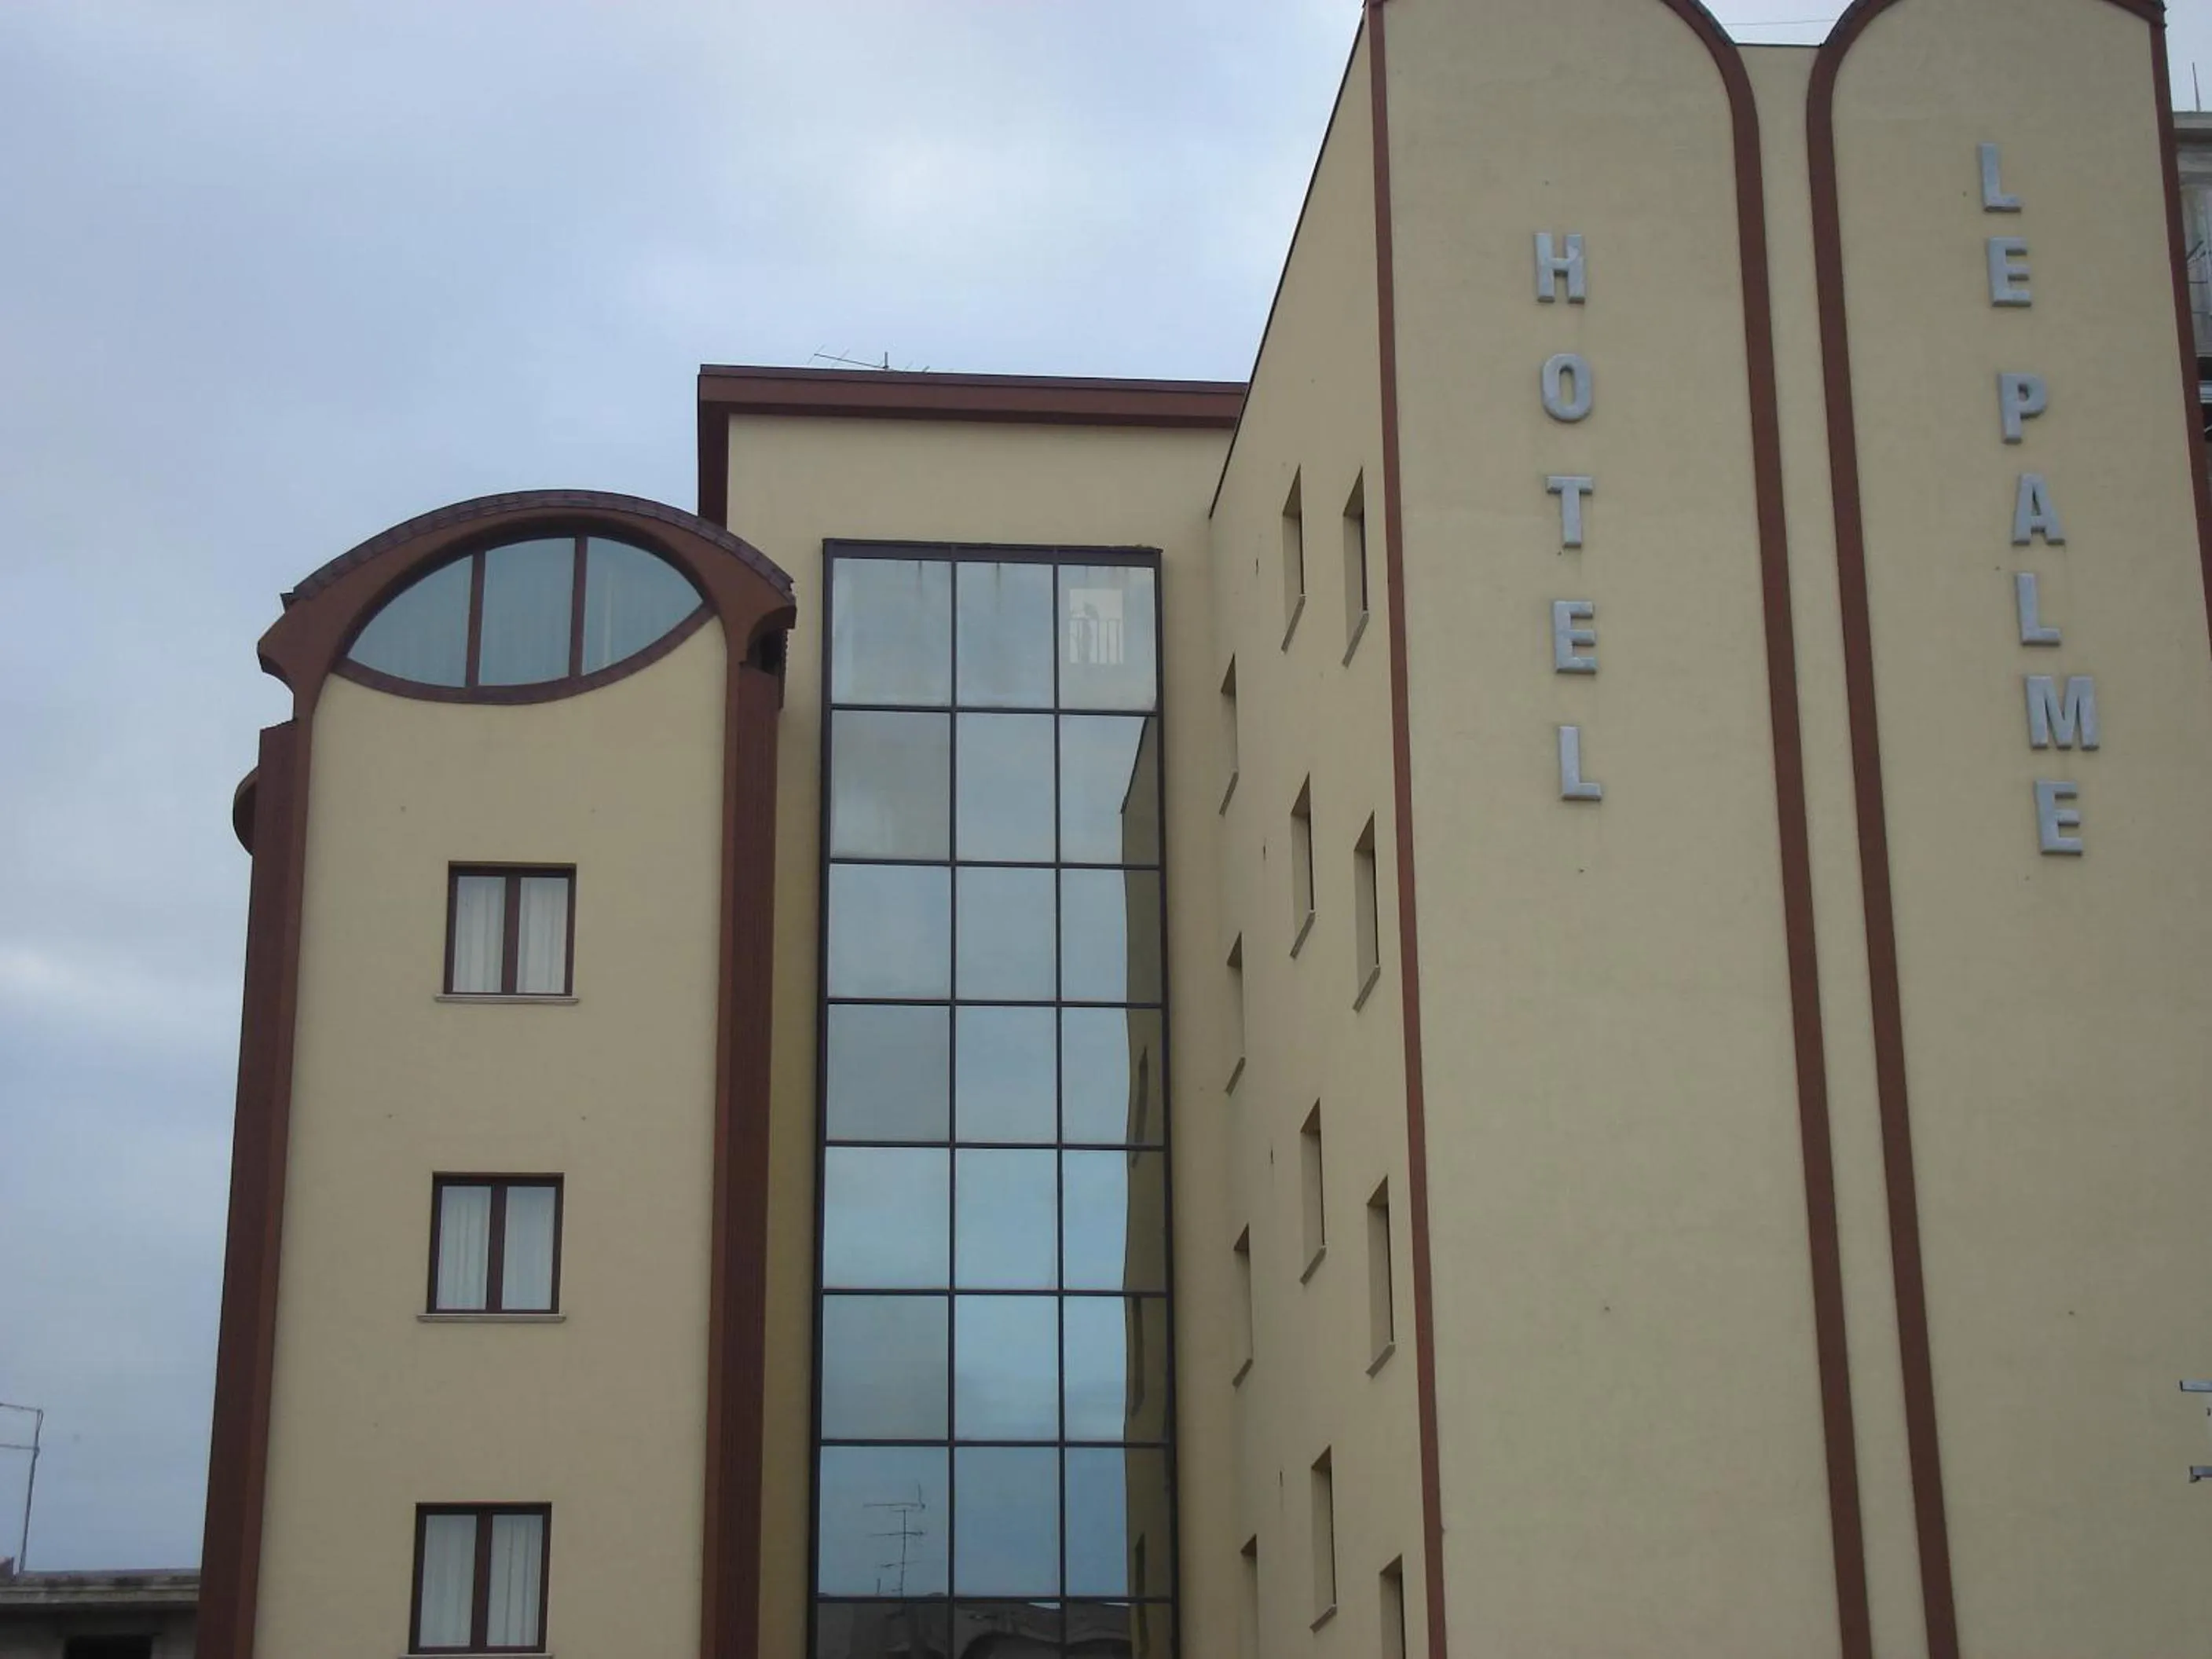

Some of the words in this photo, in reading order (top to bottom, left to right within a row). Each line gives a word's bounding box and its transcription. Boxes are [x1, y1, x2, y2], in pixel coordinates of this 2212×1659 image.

[1977, 141, 2032, 308] LE
[1534, 232, 1602, 802] HOTEL
[1998, 372, 2100, 856] PALME
